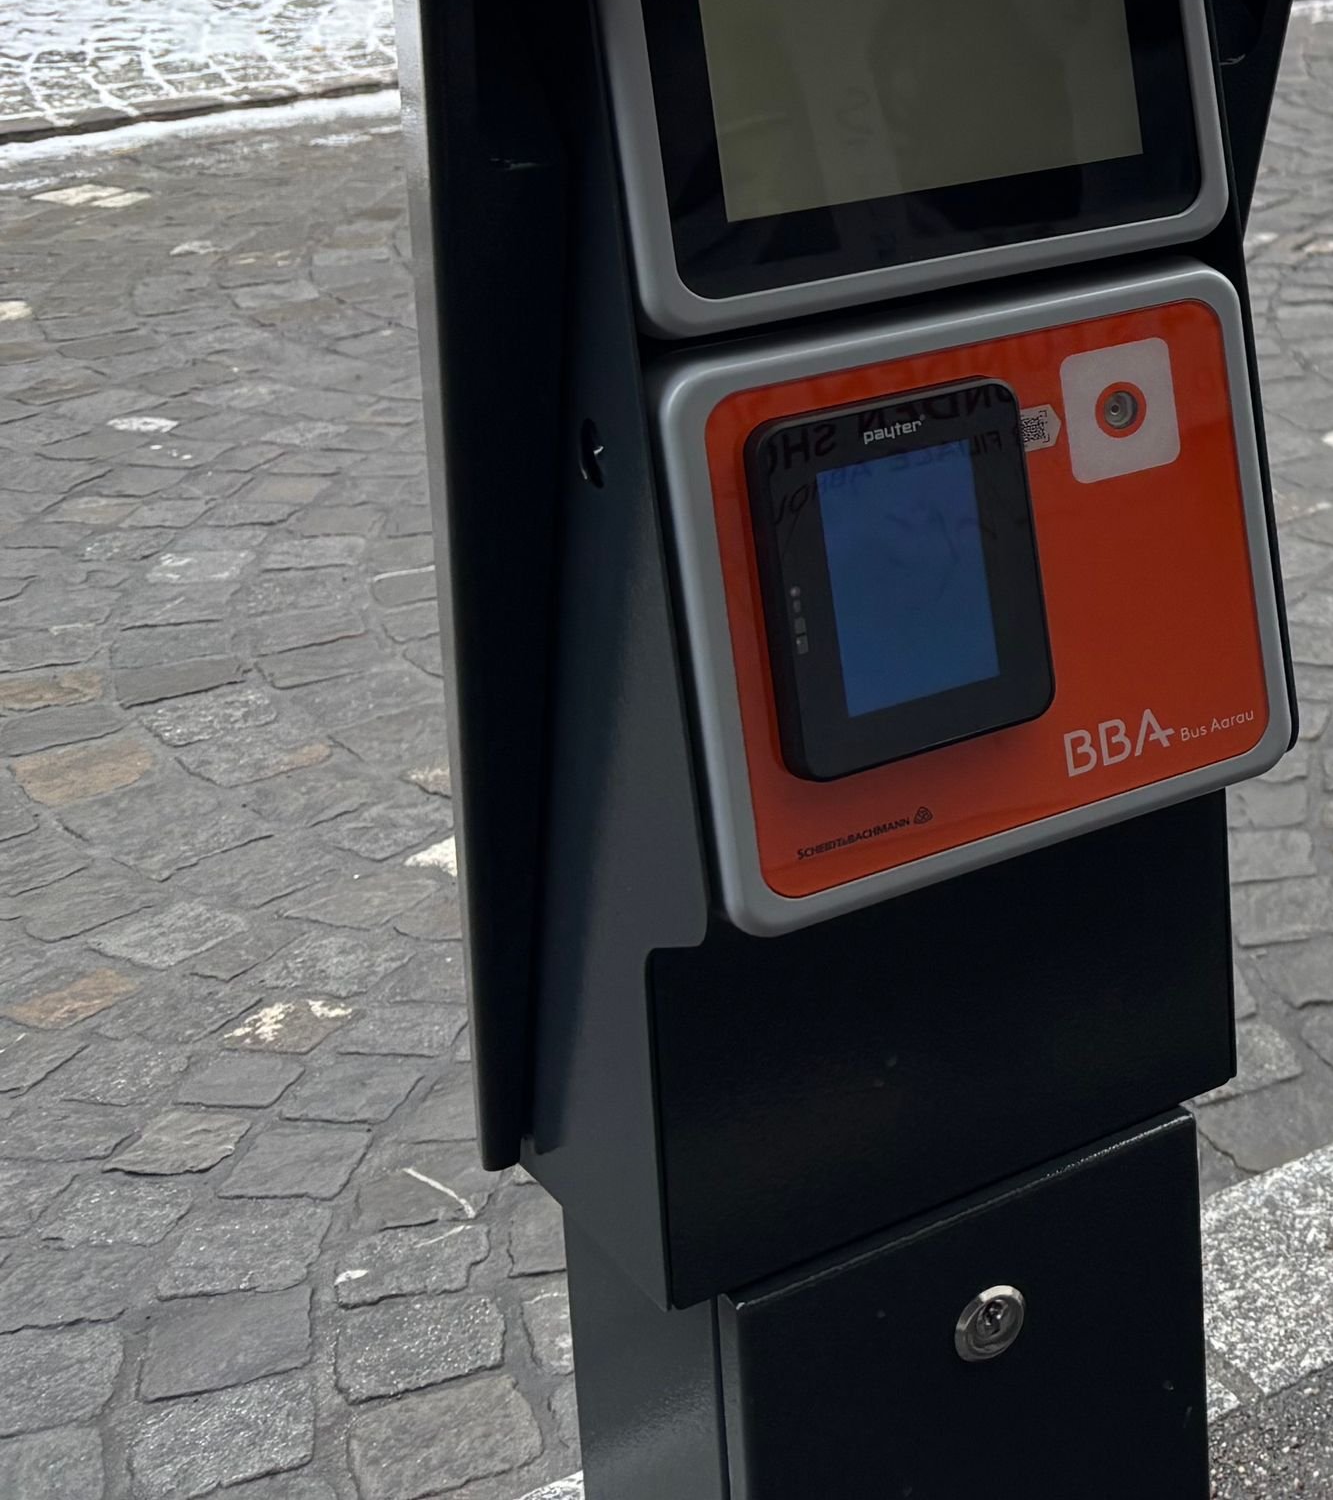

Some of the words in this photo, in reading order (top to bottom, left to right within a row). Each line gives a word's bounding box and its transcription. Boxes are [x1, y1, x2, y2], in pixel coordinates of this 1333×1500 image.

[863, 420, 922, 445] payter
[1063, 708, 1175, 778] BBA
[1180, 726, 1207, 742] Bus
[1210, 709, 1254, 733] Aarau
